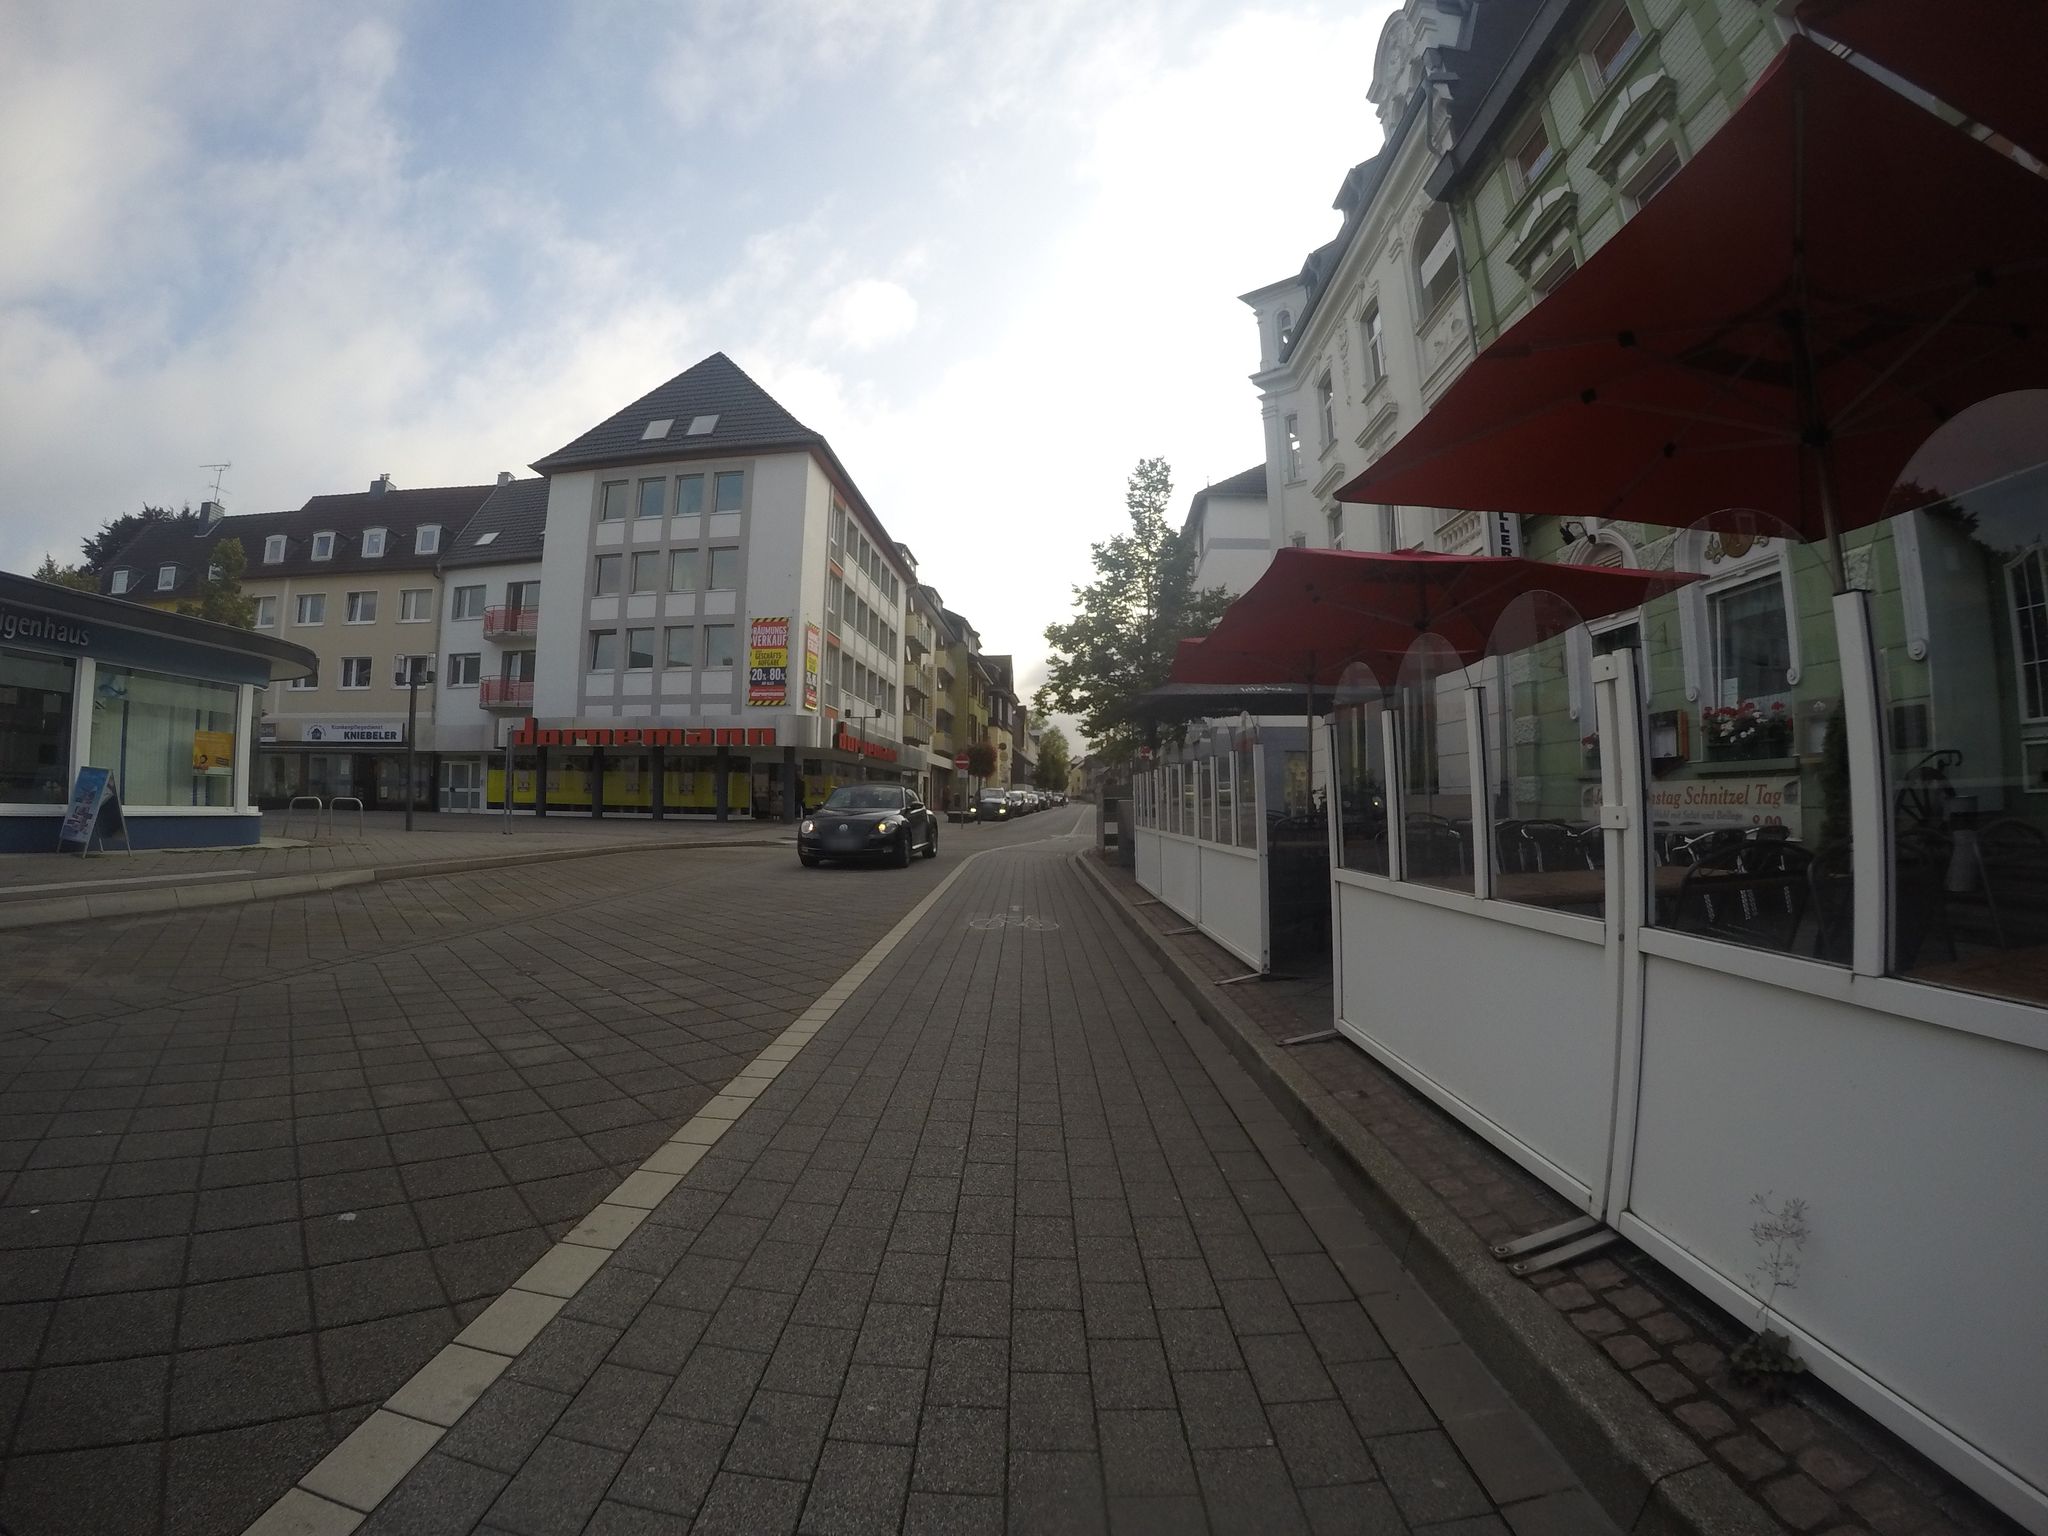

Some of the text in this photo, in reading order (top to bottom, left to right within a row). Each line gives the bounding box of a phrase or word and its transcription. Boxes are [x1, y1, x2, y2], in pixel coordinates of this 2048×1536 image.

[752, 634, 787, 647] VERKAUF
[344, 731, 397, 740] KNIEBELER
[514, 716, 777, 746] dornemann
[1684, 784, 1750, 806] Schnitzel
[1755, 783, 1782, 808] Tag
